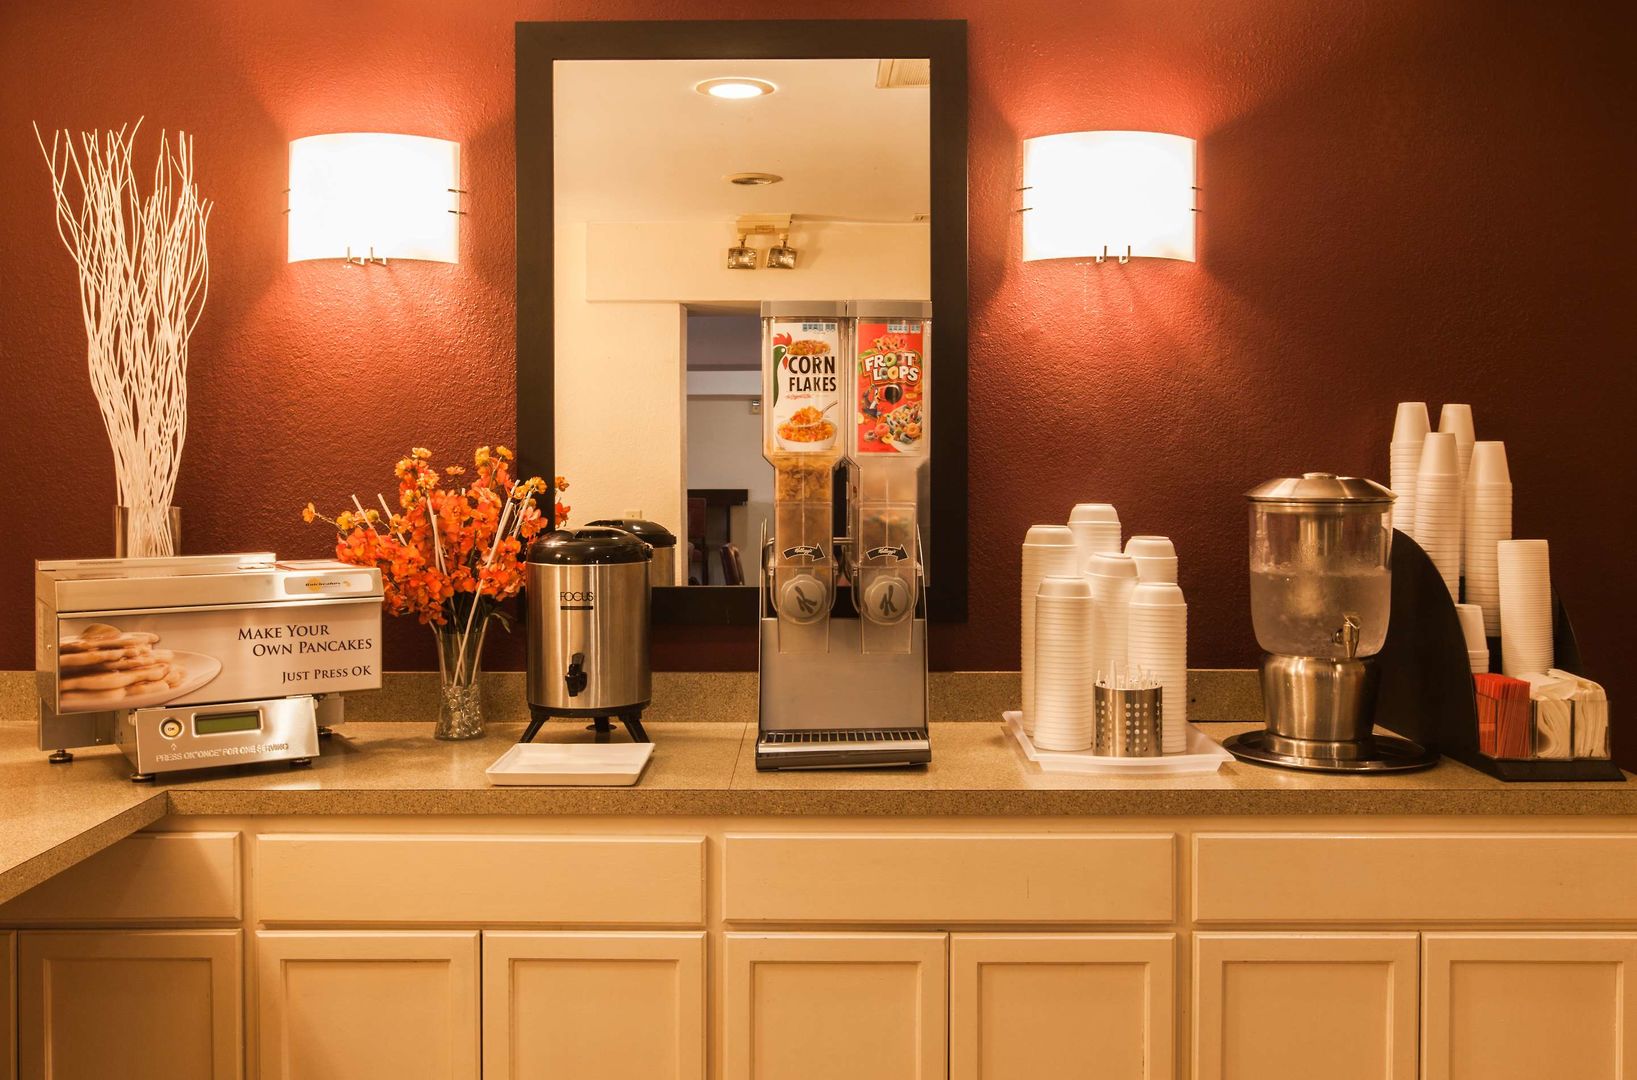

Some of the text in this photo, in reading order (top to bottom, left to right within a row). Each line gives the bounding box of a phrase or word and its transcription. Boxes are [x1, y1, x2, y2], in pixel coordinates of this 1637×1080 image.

[788, 356, 835, 374] CORN
[864, 351, 916, 372] FROOT
[873, 365, 919, 382] LOOPS
[789, 377, 837, 392] FLAKES
[560, 591, 594, 601] FOCUS
[352, 665, 372, 676] OK
[156, 753, 182, 762] PRESS
[222, 747, 239, 756] FOR
